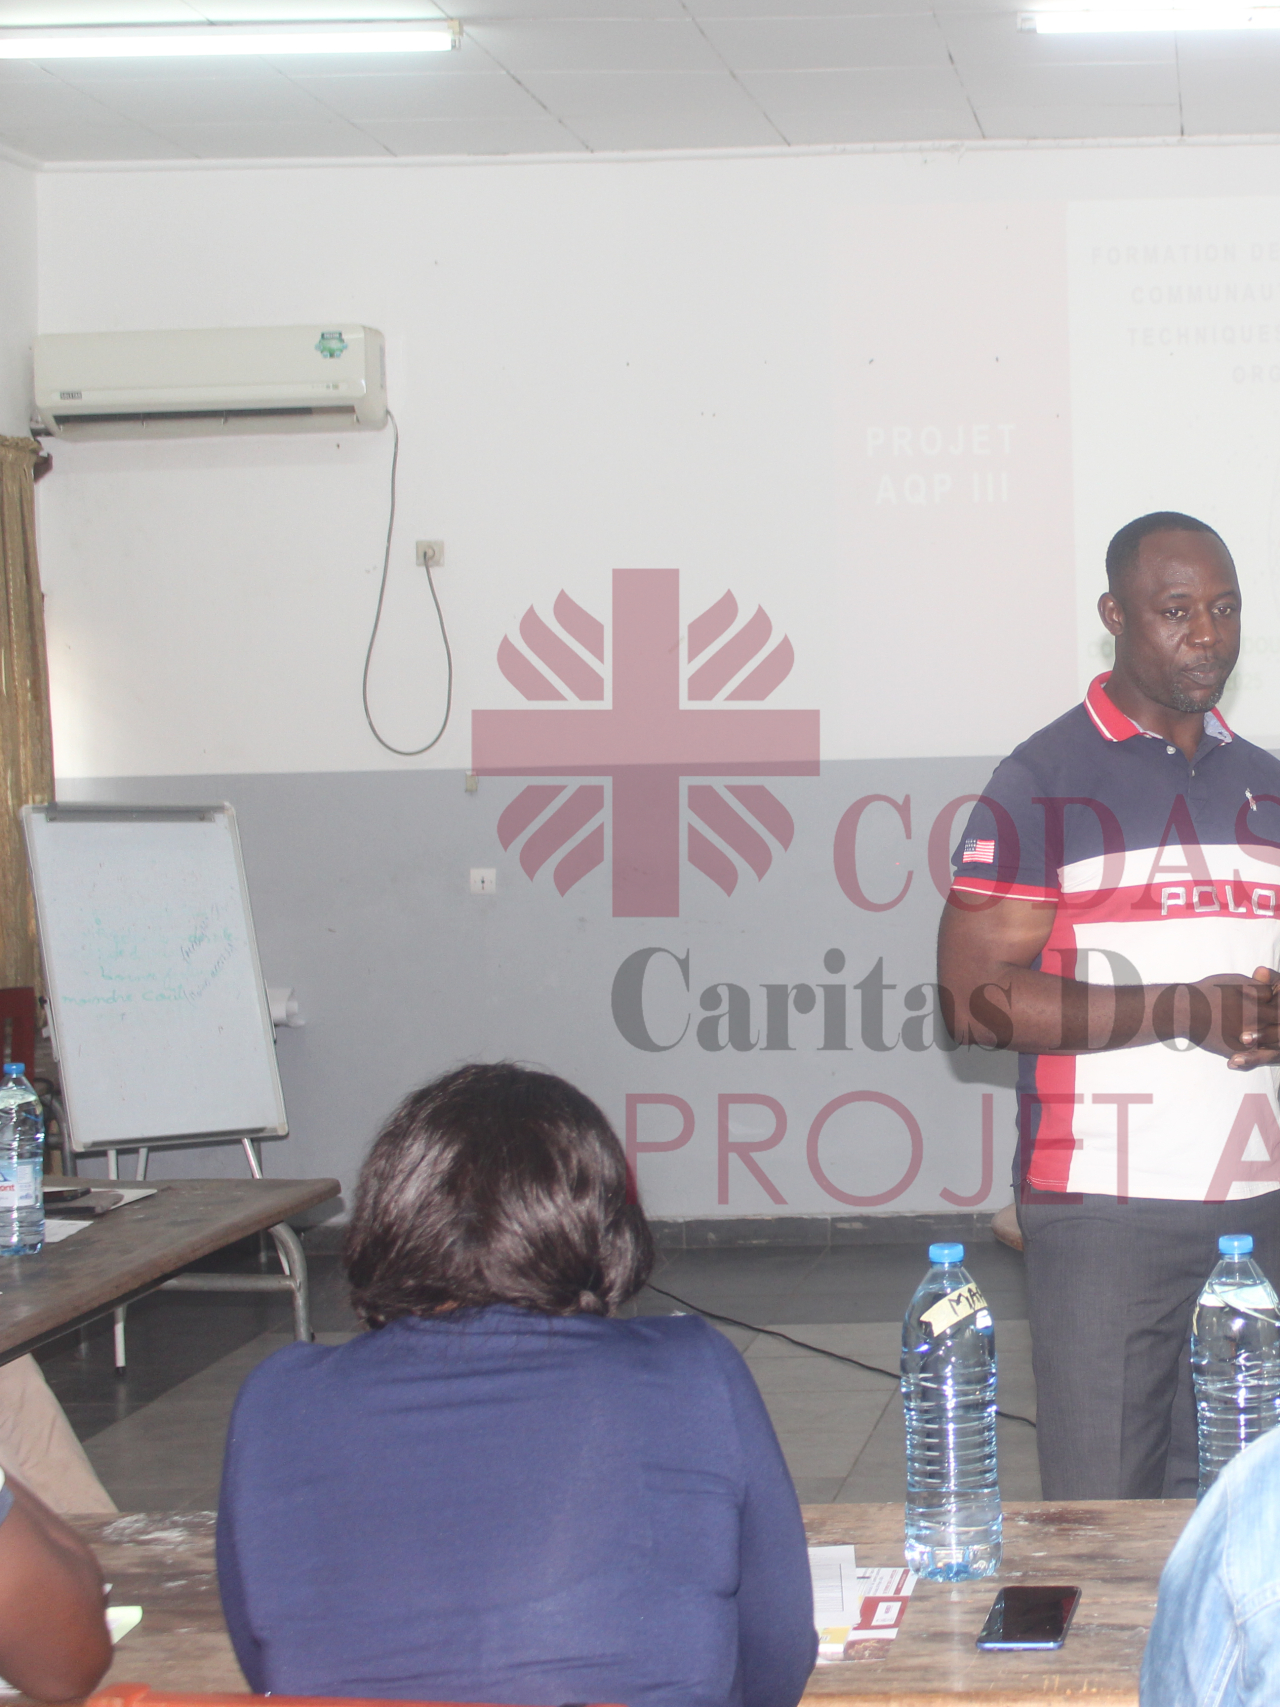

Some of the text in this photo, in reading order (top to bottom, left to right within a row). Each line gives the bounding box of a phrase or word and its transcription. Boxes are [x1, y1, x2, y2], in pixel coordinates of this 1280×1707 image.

[1091, 244, 1237, 265] FORMATION
[866, 424, 1017, 457] PROJET
[875, 472, 1008, 506] AQP III
[1161, 885, 1276, 916] POLO
